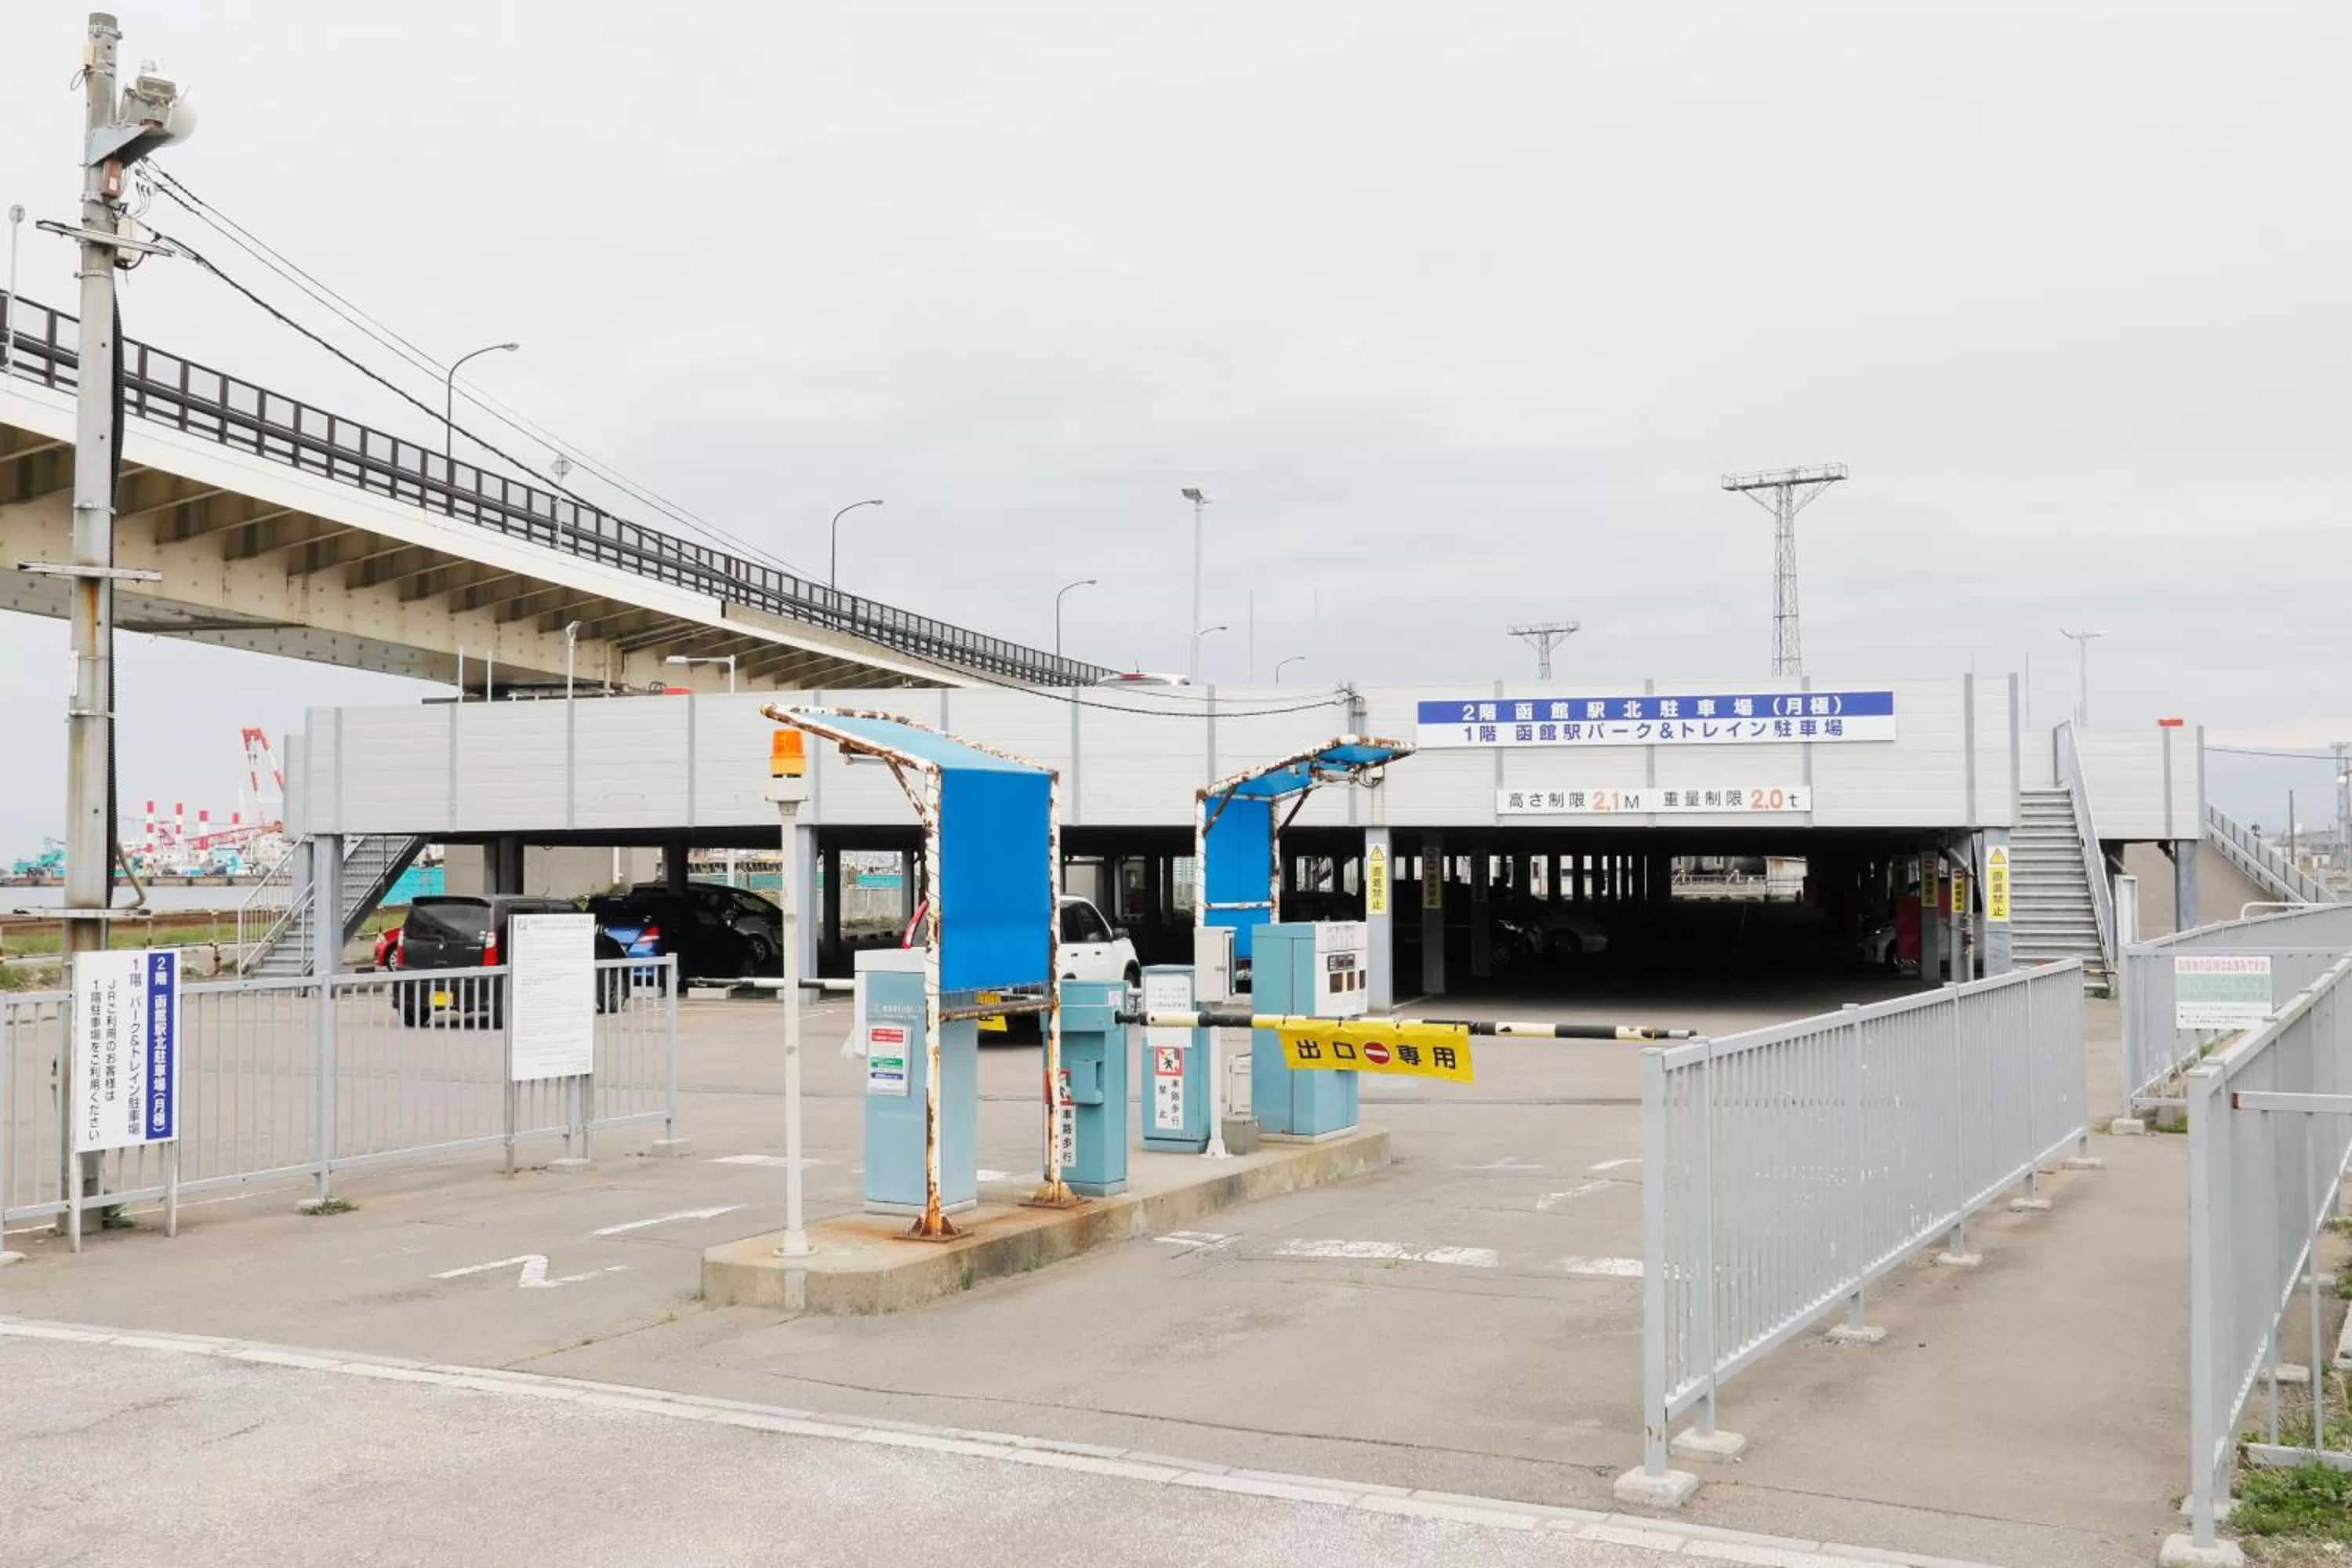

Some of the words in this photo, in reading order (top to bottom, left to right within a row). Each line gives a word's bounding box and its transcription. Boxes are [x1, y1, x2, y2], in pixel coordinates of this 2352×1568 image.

[1462, 704, 1497, 721] 2階
[1464, 724, 1497, 742] 1階
[1515, 719, 1843, 742] 函館駅パーク&トレイン駐車場
[129, 958, 142, 987] 1階
[154, 956, 167, 985] 2階
[128, 996, 141, 1135] パーク&トレイン駐車場
[1297, 1039, 1356, 1060] 出口
[1396, 1044, 1456, 1070] 専用
